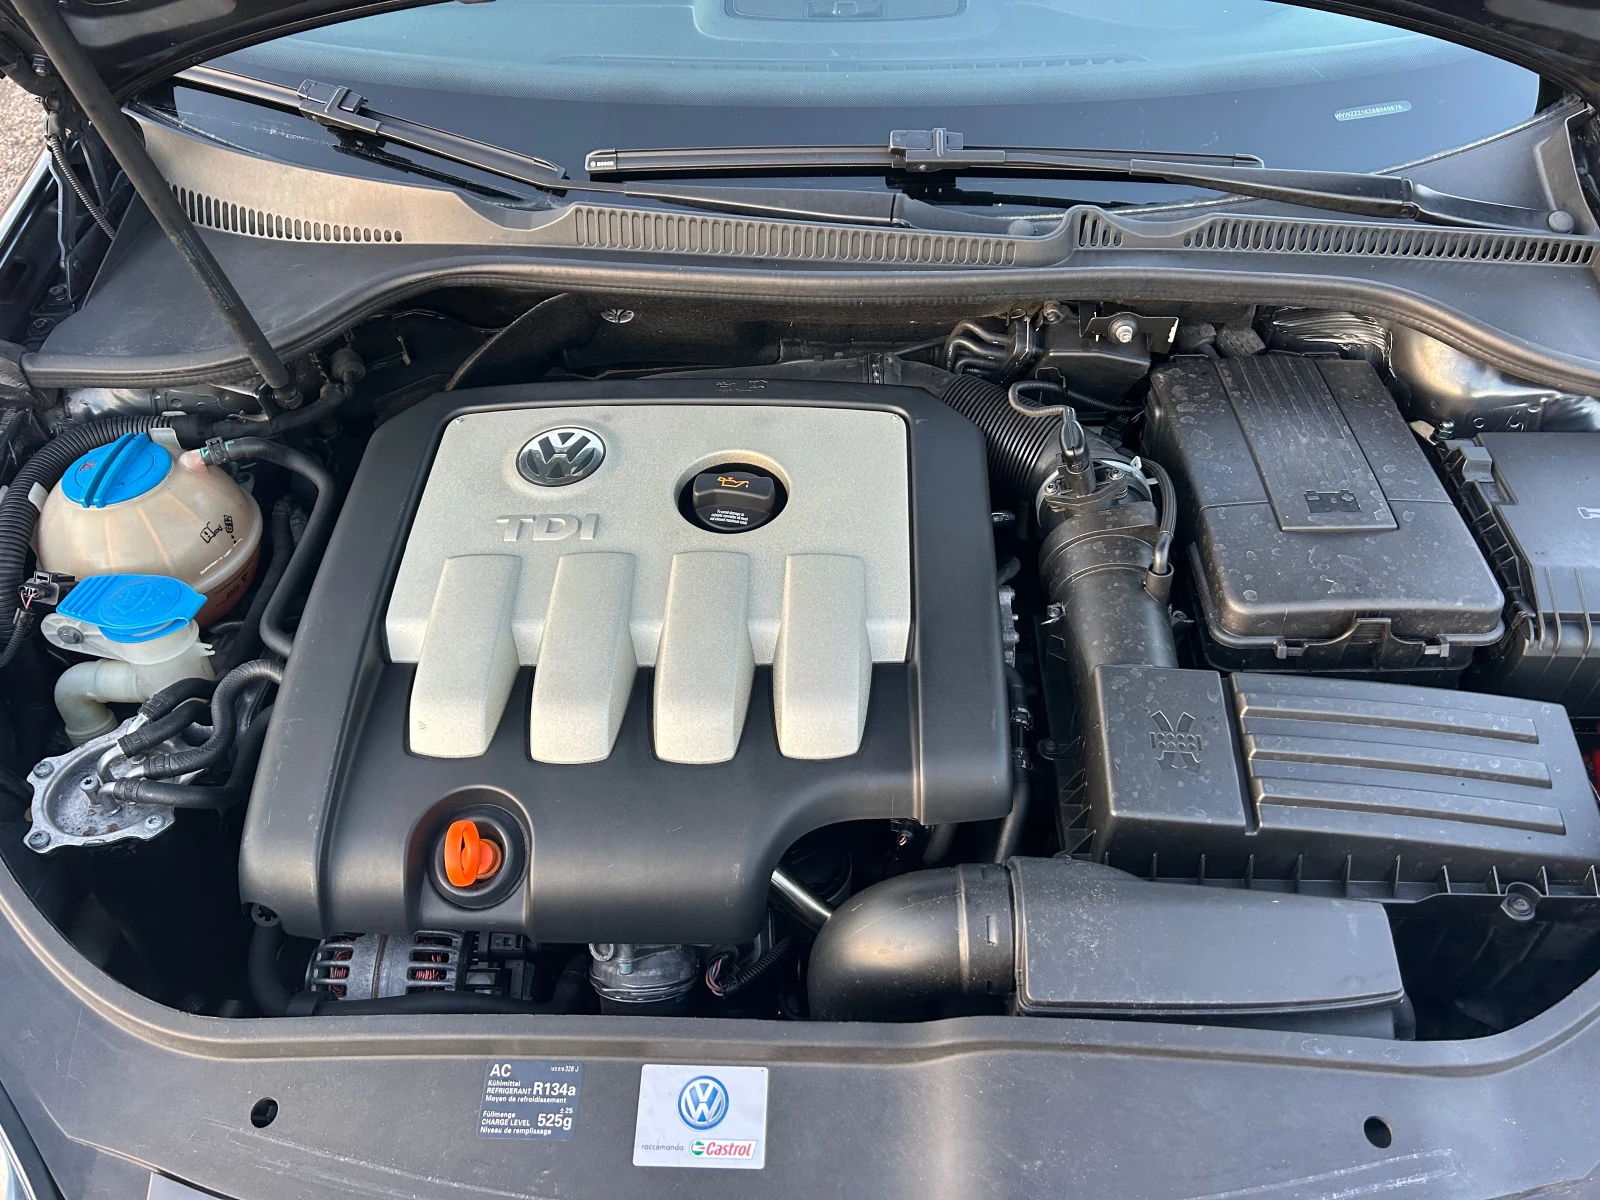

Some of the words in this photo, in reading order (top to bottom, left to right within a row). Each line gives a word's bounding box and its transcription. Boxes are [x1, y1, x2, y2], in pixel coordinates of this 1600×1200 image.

[496, 513, 599, 541] TDI
[226, 584, 240, 598] min
[490, 1063, 512, 1078] AC
[486, 1087, 532, 1095] REFRIGERANT
[532, 1081, 576, 1096] R134a
[487, 1079, 521, 1087] Kühlmittel
[485, 1095, 507, 1103] Moyen
[517, 1096, 567, 1104] refroidissement
[482, 1110, 516, 1119] Füllmenge
[481, 1118, 509, 1126] CHARGE
[537, 1113, 573, 1131] 525g
[480, 1126, 502, 1134] Niveau
[512, 1127, 552, 1136] remplissage
[641, 1143, 684, 1152] raccomanda
[706, 1141, 752, 1157] Castrol
